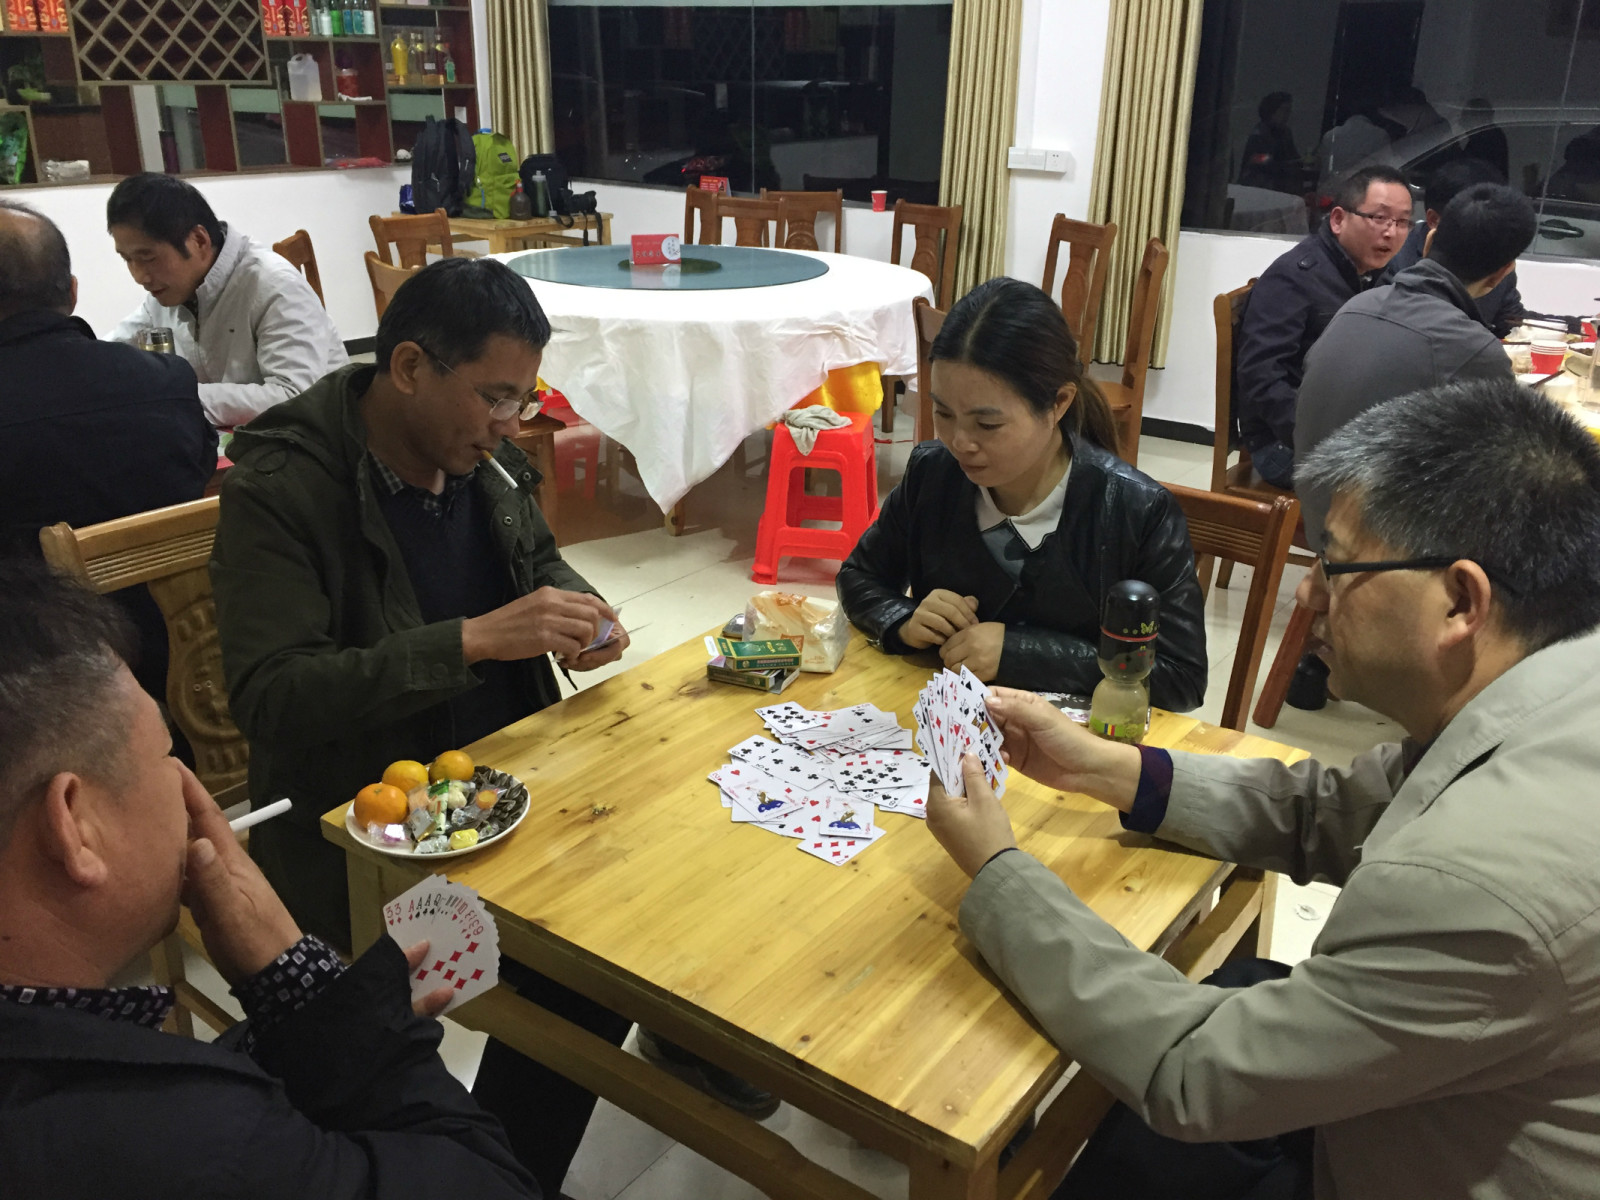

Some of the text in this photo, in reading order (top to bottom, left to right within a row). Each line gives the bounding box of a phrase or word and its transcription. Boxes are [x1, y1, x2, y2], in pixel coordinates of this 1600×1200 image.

[416, 896, 422, 910] A
[424, 893, 431, 906] A
[434, 893, 442, 906] Q
[408, 900, 414, 913] A
